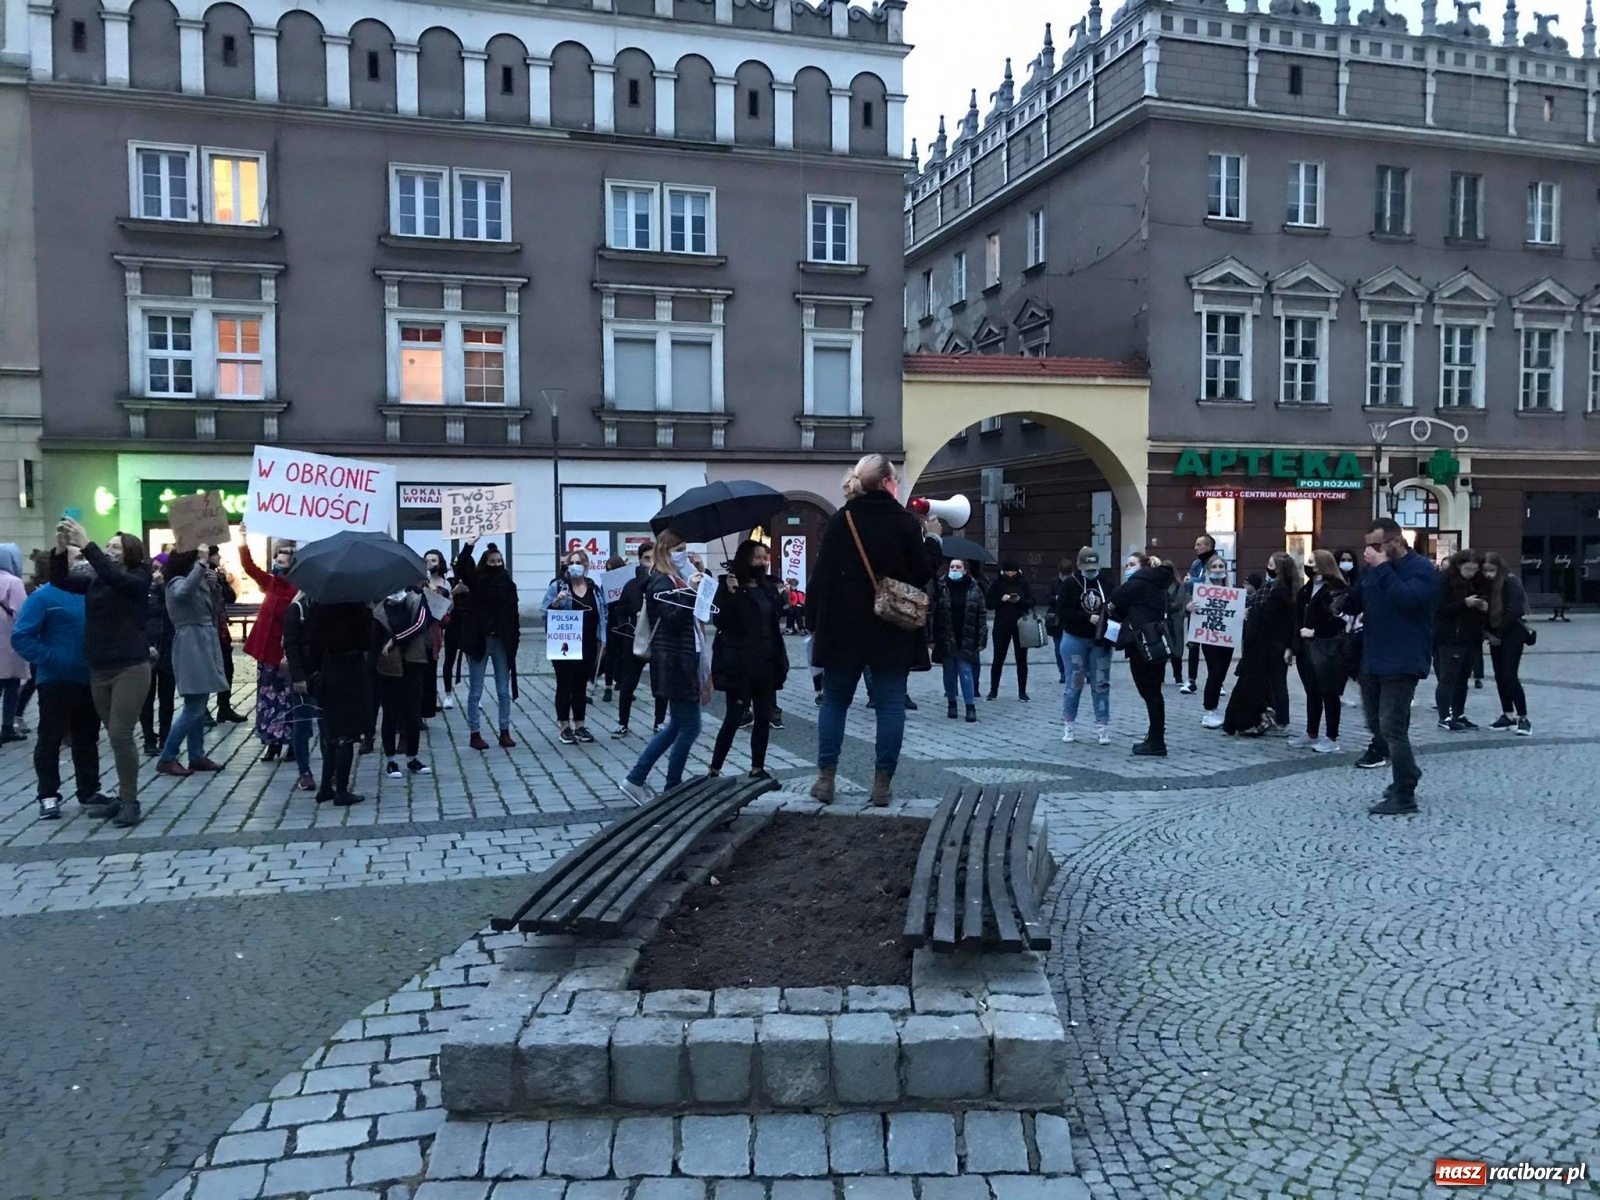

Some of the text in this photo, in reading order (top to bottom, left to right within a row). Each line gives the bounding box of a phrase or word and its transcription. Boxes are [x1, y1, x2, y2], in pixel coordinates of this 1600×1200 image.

[1173, 448, 1363, 478] APTEKA
[258, 458, 380, 493] W OBRONIE
[1300, 479, 1361, 488] POD RÓŻAMI
[447, 489, 494, 504] TWÓJ
[1195, 490, 1222, 498] RYNEK
[1224, 490, 1234, 498] 12
[1278, 491, 1346, 499] FARMACEUTYCZNE
[257, 492, 369, 525] WOLNOŚCI
[453, 499, 514, 516] BÓL JEST
[451, 512, 503, 526] LEPSZY
[792, 538, 805, 557] 432
[1197, 586, 1239, 600] OCEAN
[1205, 598, 1229, 609] JEST
[547, 633, 582, 642] KOBIETĄ
